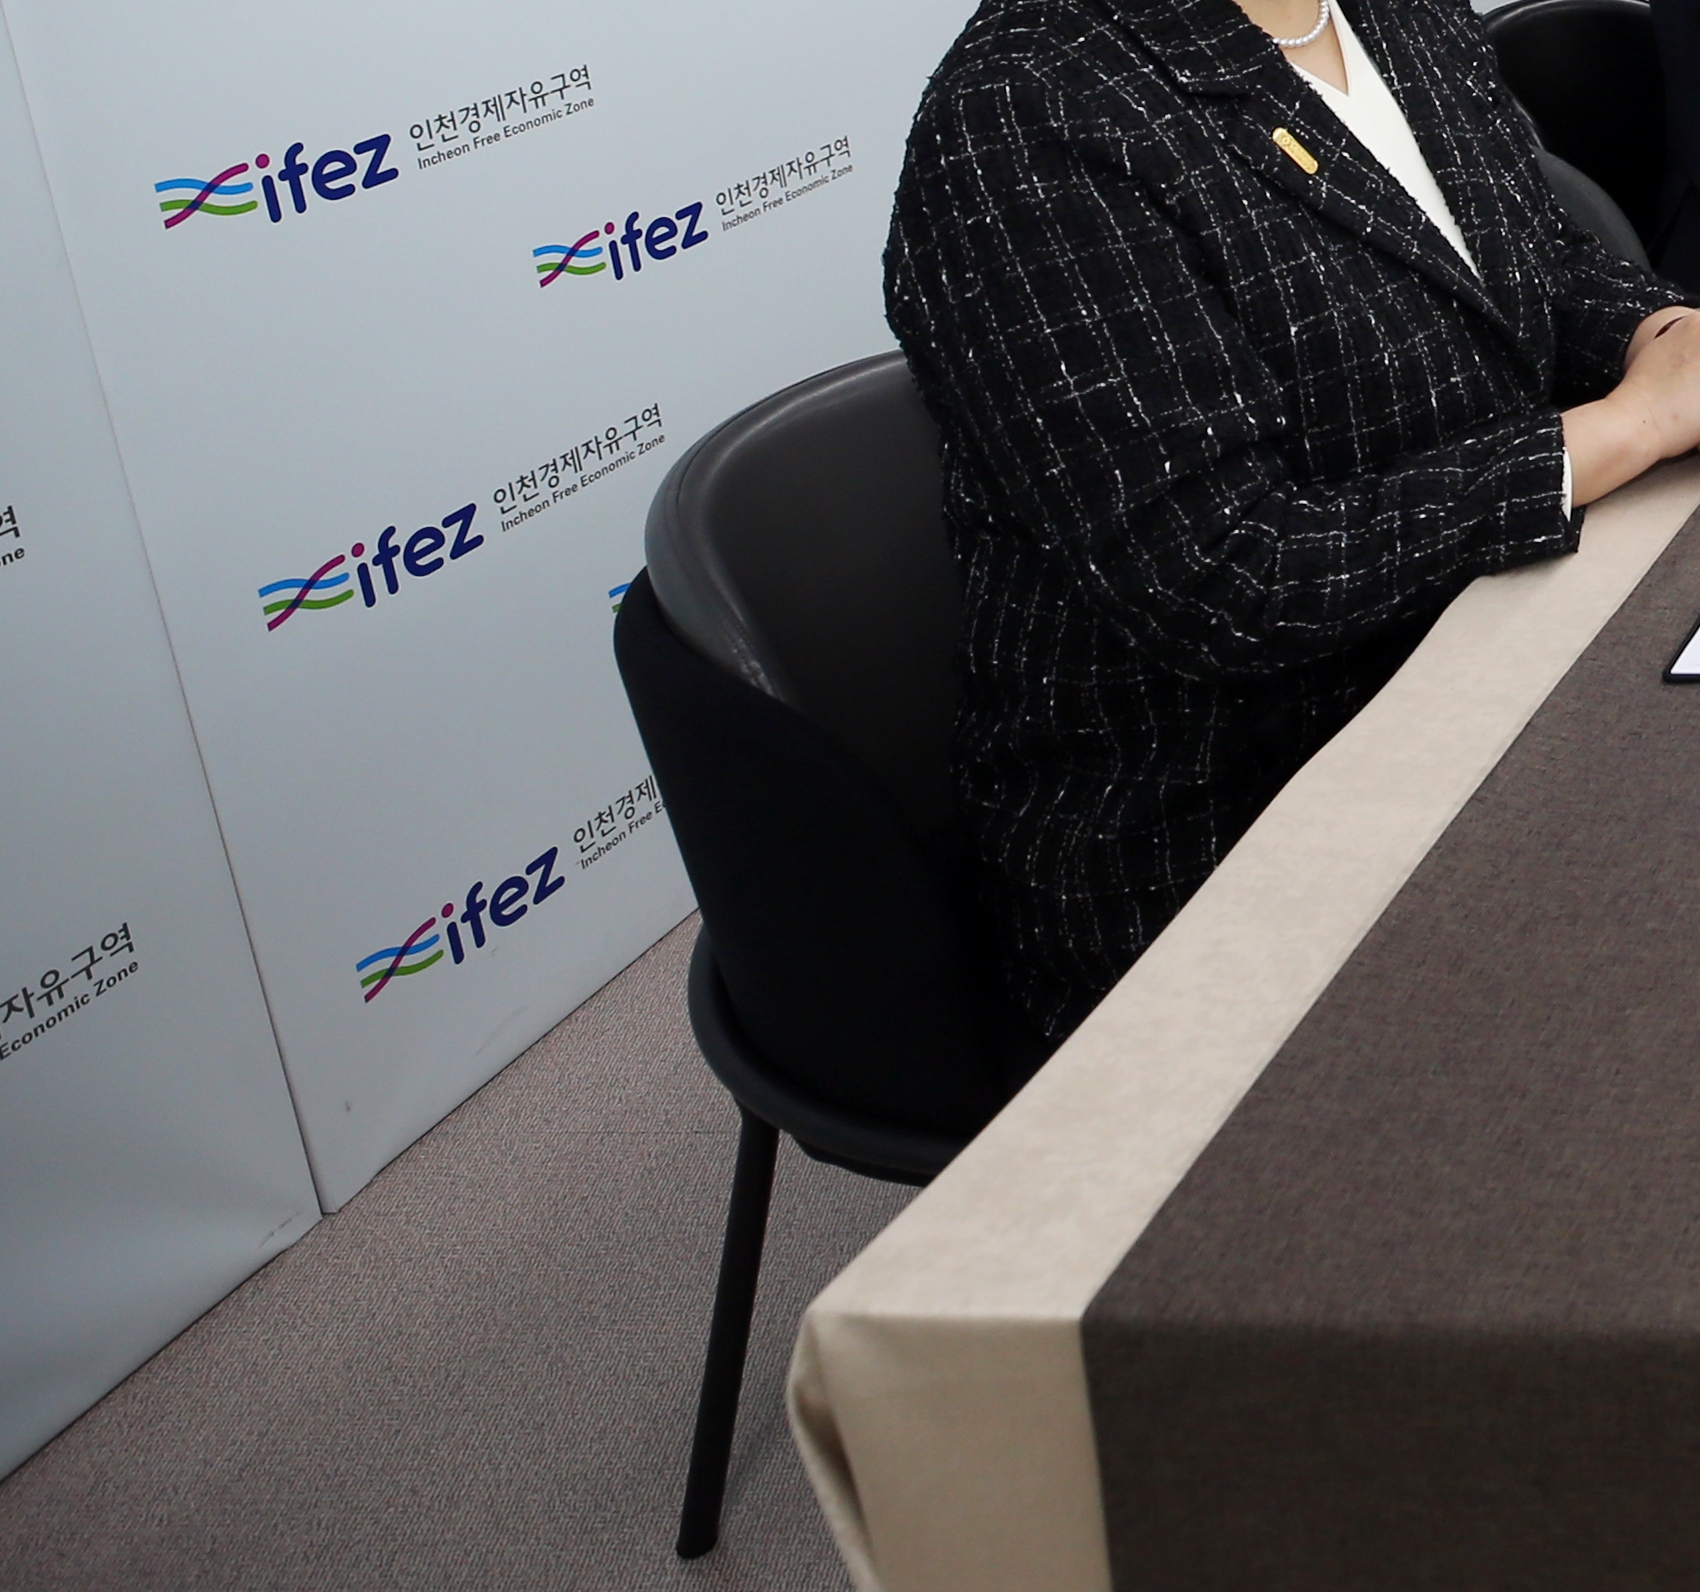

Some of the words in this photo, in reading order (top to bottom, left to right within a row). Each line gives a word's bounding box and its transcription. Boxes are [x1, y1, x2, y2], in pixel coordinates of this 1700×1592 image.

[409, 64, 592, 152] 인천경제자유구역
[417, 141, 470, 170] Incheon
[473, 130, 501, 150] Free
[503, 106, 563, 139] Economic
[565, 97, 594, 117] Zone
[255, 133, 399, 223] ifez
[716, 135, 851, 216] 인천경제자유구역
[722, 207, 761, 231] Incheon
[763, 194, 784, 212] Free
[785, 174, 829, 201] Economic
[831, 162, 854, 181] Zone
[604, 202, 708, 281] ifez
[493, 403, 663, 515] 인천경제자유구역
[501, 500, 551, 533] Incheon
[552, 482, 579, 504] Free
[580, 451, 635, 488] Economic
[637, 434, 665, 456] Zone
[351, 503, 484, 609] ifez
[573, 775, 658, 854] 인천경제
[580, 830, 627, 870] Incheon
[628, 810, 653, 836] Free
[441, 846, 565, 965] ifez
[93, 960, 139, 997] Zone
